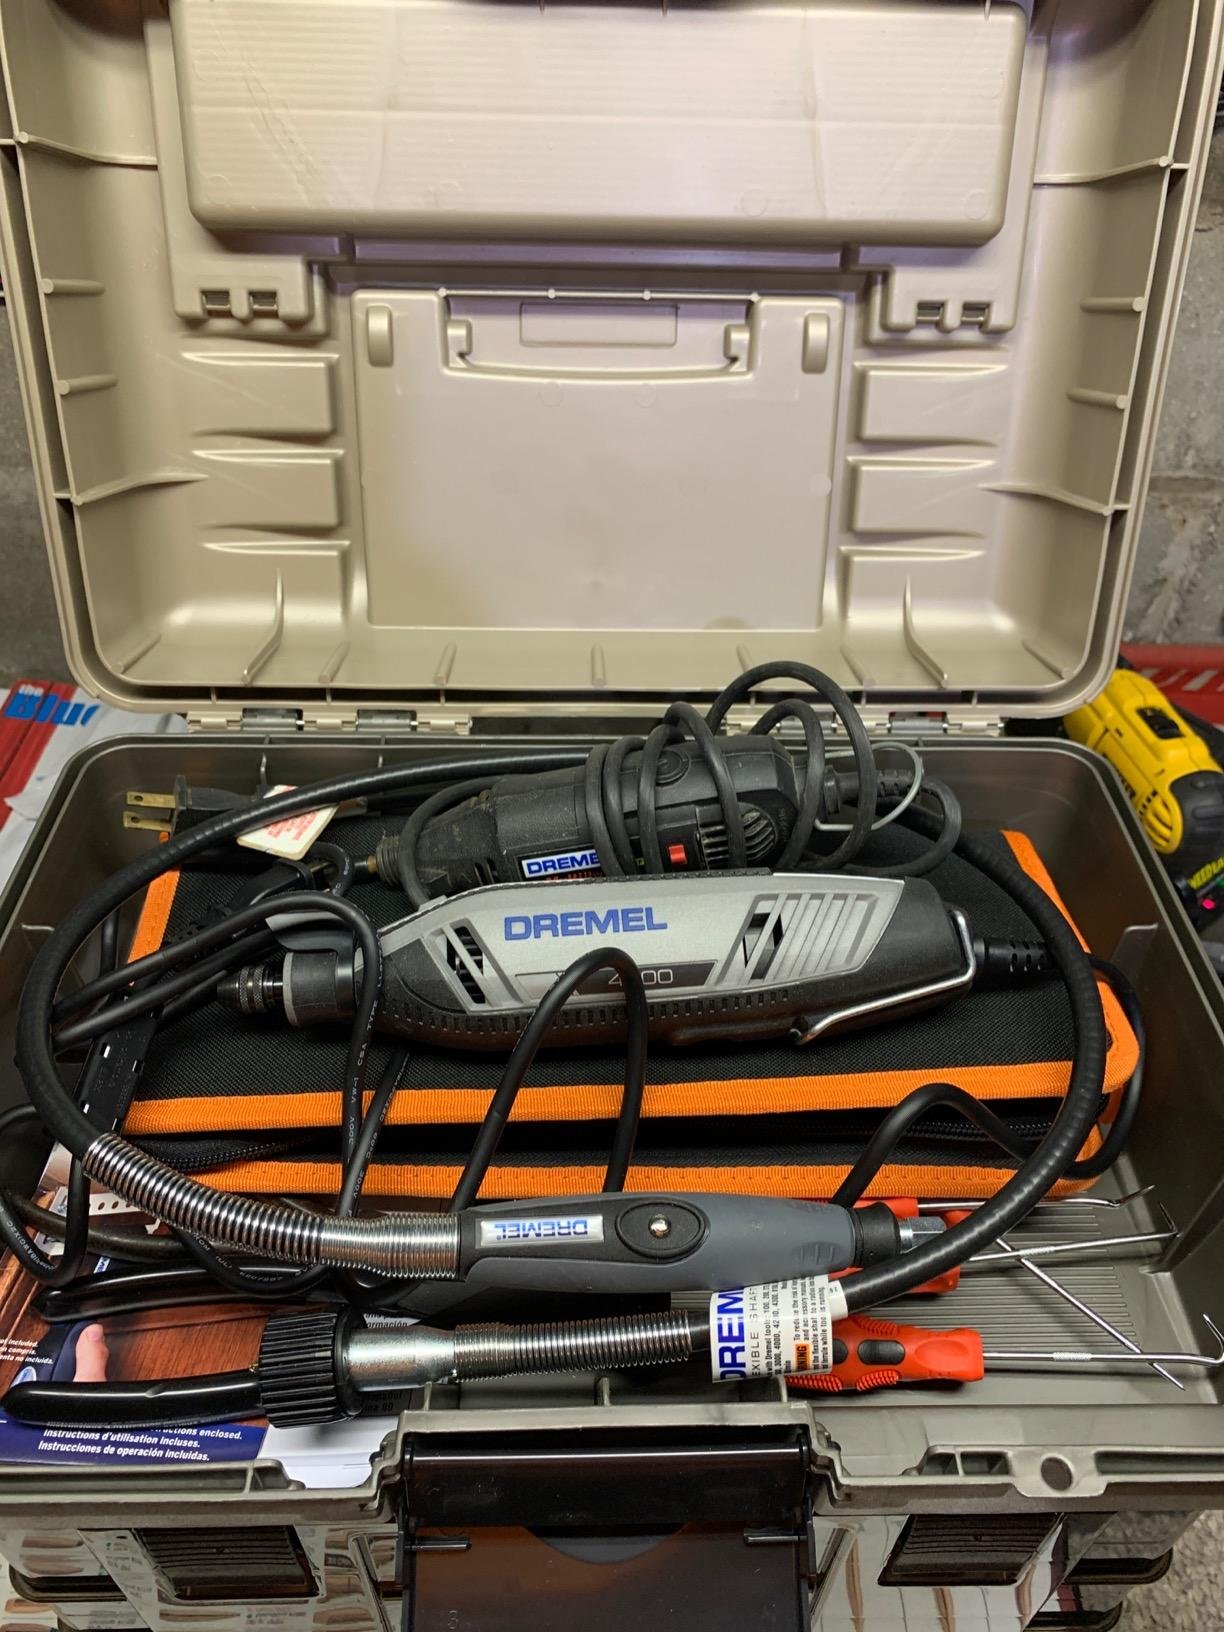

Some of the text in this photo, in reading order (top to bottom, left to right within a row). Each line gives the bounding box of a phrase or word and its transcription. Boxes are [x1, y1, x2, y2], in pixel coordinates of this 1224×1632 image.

[504, 907, 668, 941] DREMEL
[608, 969, 673, 988] 400
[494, 1219, 588, 1239] DREMEL
[773, 1330, 781, 1350] 4000,
[793, 1333, 800, 1341] To
[802, 1329, 810, 1341] and
[820, 1329, 828, 1346] while
[8, 1347, 37, 1355] compris.
[765, 1337, 773, 1360] Dremel
[25, 1356, 54, 1364] incluida.
[102, 1431, 159, 1445] d'utilisation
[160, 1436, 200, 1448] incluses.
[199, 1429, 242, 1440] enclosed.
[38, 1440, 210, 1461] Instrucciones de operación incluidas.
